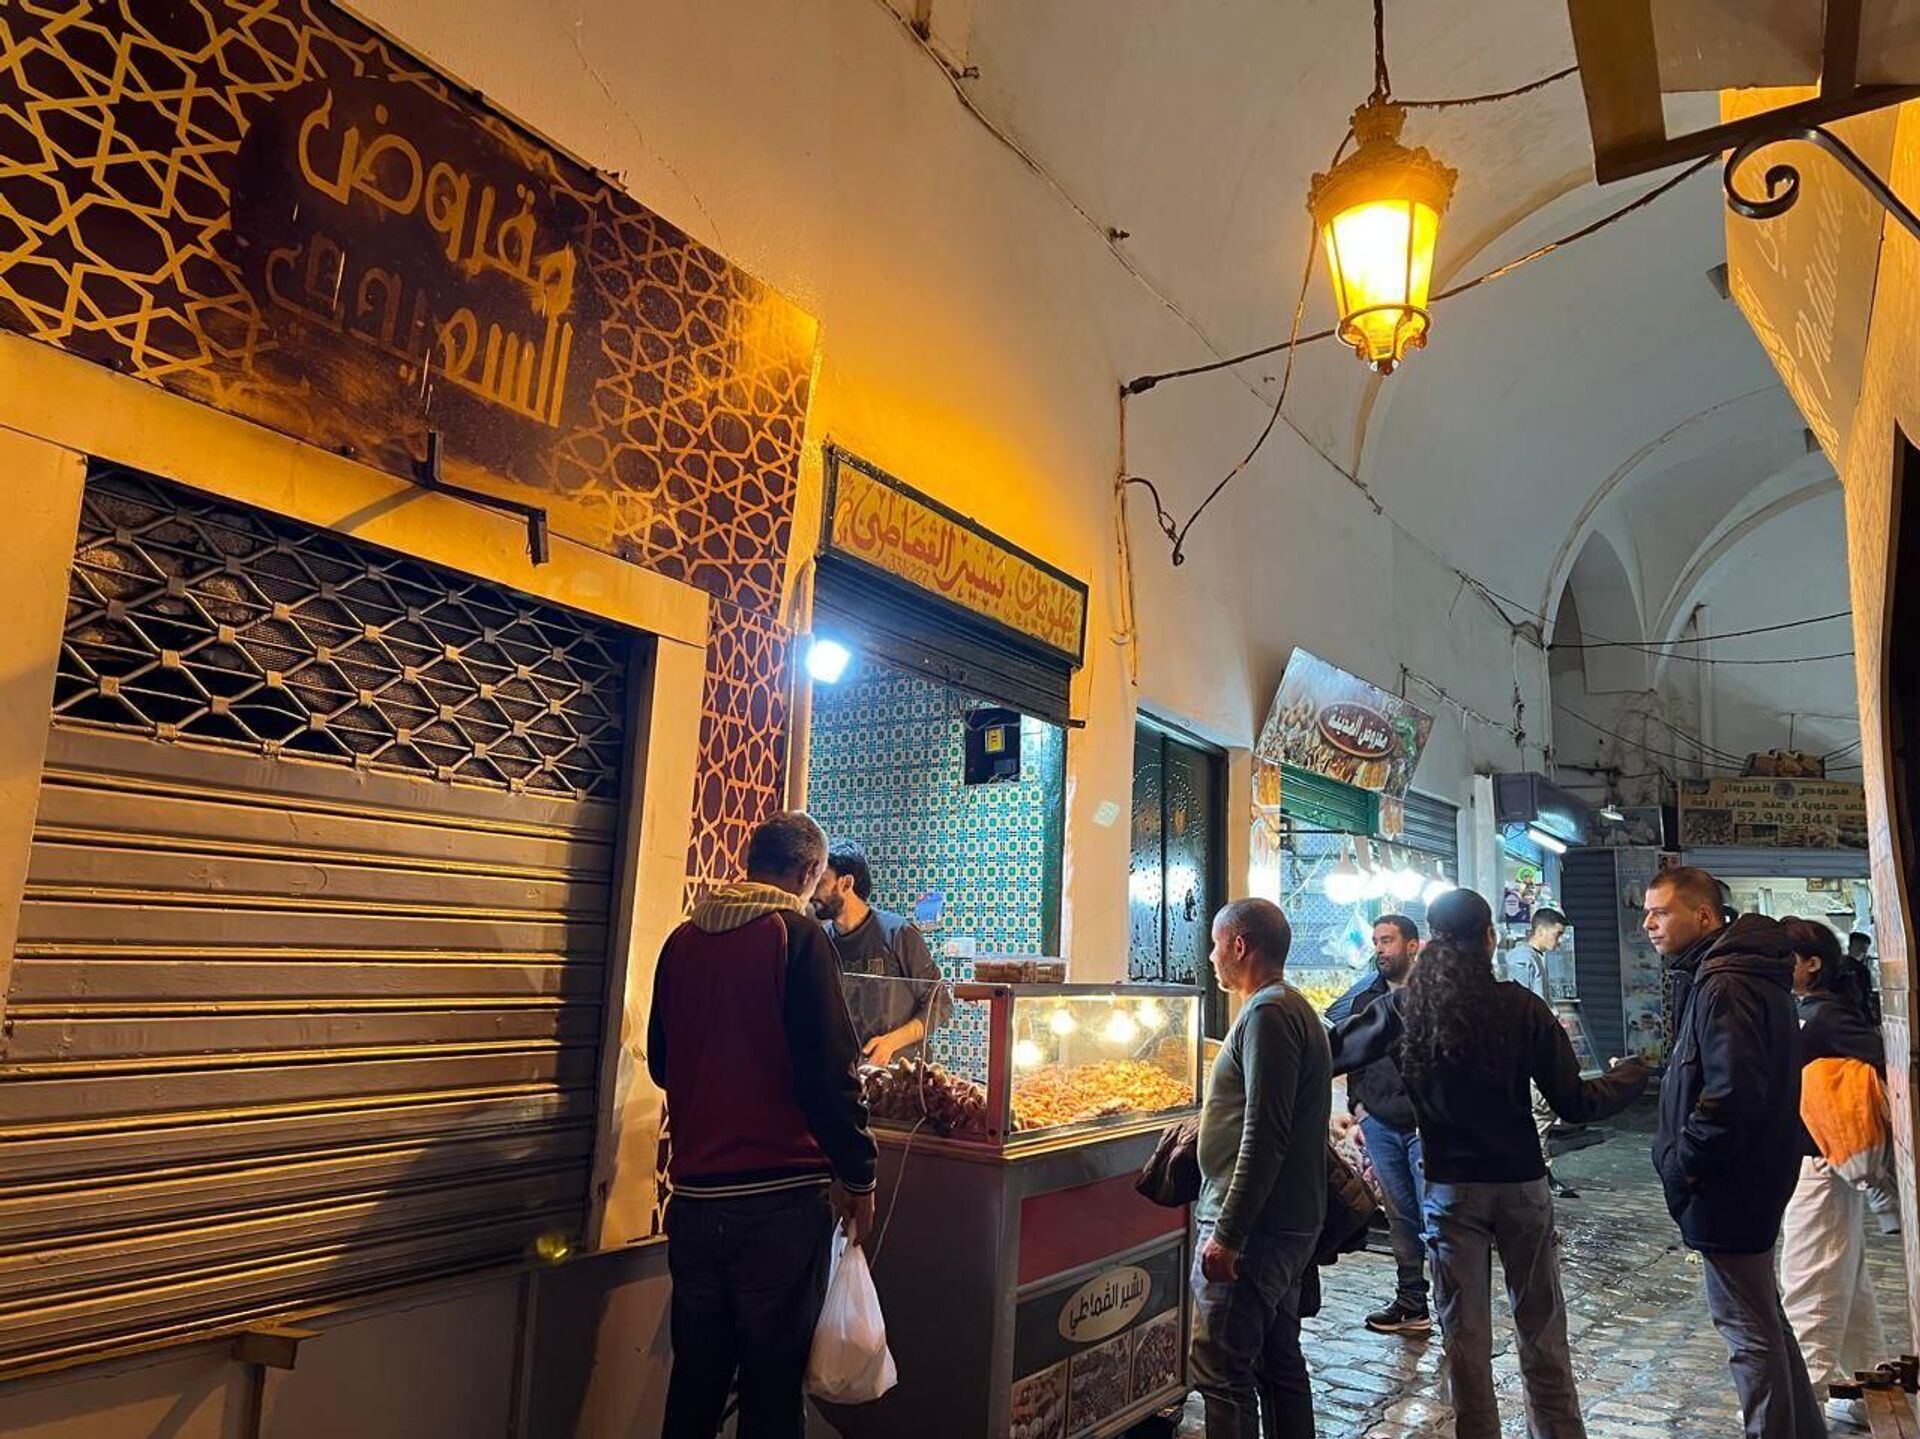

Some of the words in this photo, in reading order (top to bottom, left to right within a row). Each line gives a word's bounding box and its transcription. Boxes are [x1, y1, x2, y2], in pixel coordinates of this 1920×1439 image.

[300, 88, 576, 314] مقروض
[1738, 811, 1833, 825] 52.949.844
[1069, 1281, 1118, 1336] القماطي
[1120, 1272, 1144, 1310] بشير
